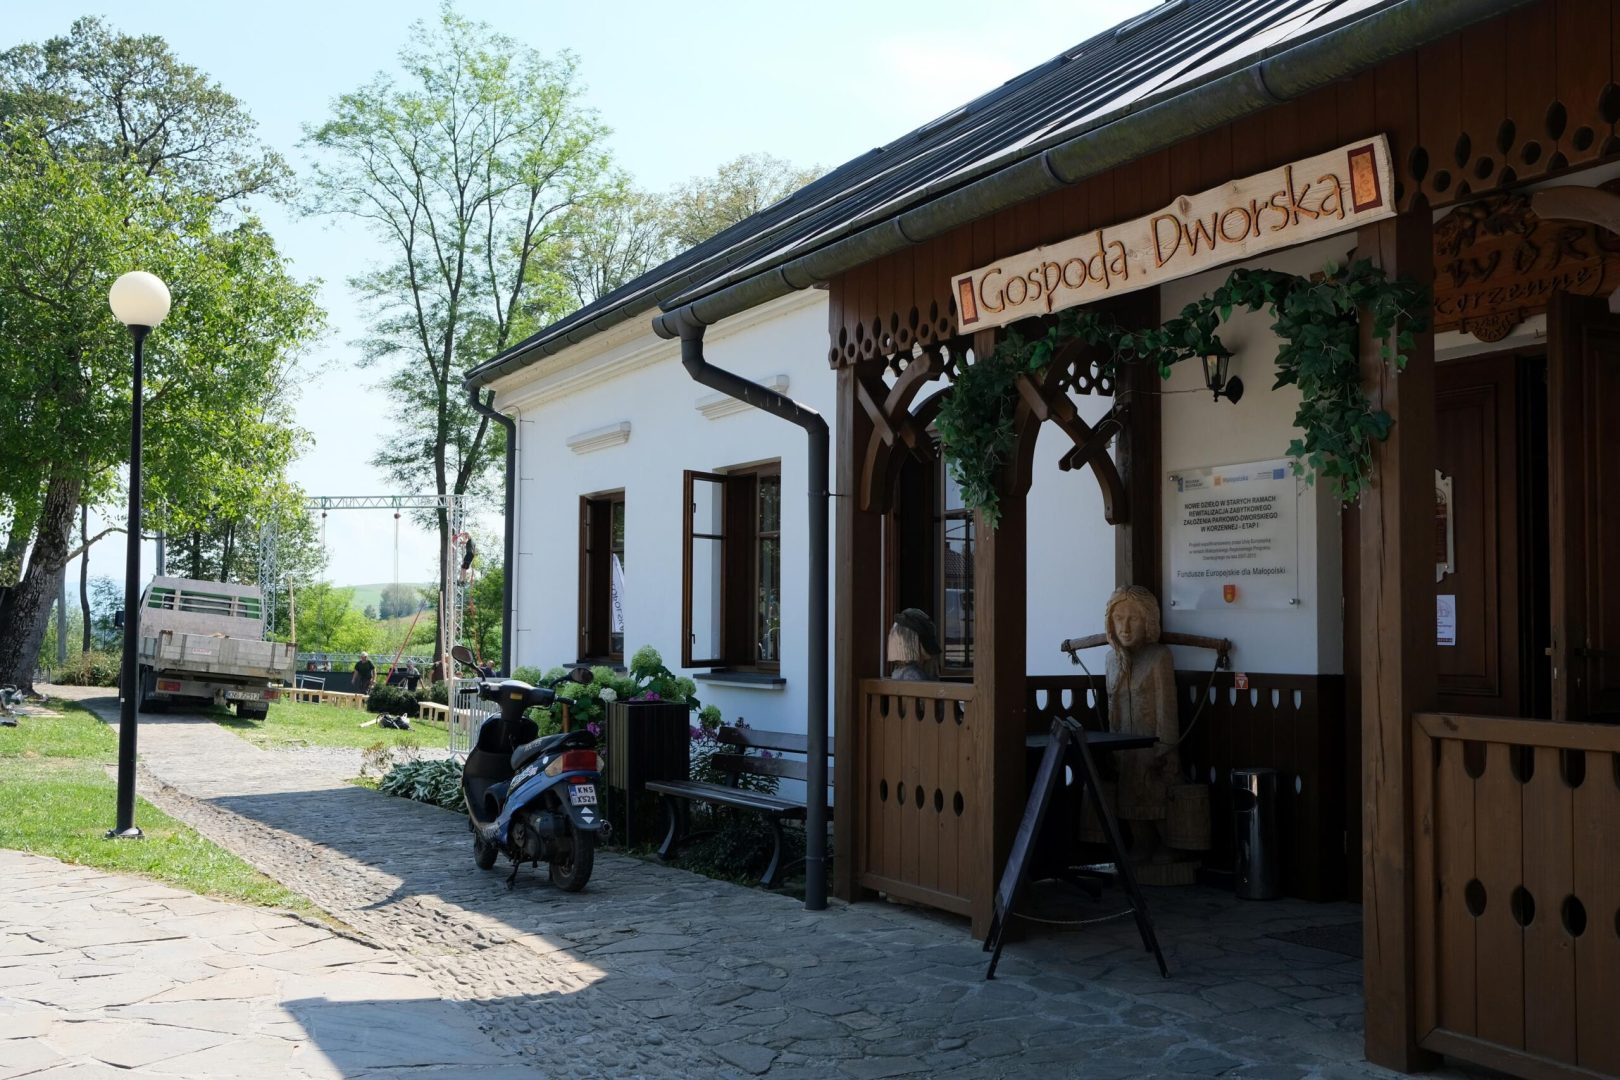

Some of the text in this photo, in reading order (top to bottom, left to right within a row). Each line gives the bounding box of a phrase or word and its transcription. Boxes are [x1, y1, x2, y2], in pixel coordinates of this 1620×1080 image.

[979, 164, 1347, 313] Gospoda Dworska
[1184, 501, 1200, 509] NOWE
[1201, 499, 1219, 508] DZIEŁO
[1226, 497, 1251, 506] STARYCH
[1252, 495, 1276, 503] RAMACH
[1188, 504, 1272, 517] REWITALIZACJA ZABYTKOWEGO
[1212, 512, 1278, 523] PARKOWO-DWORSKIEGO
[1206, 524, 1238, 532] KORZENNEJ
[1242, 522, 1256, 530] ETAP
[1177, 566, 1286, 578] Fundusze Europejskie dla Małopolski
[577, 786, 594, 794] KNS
